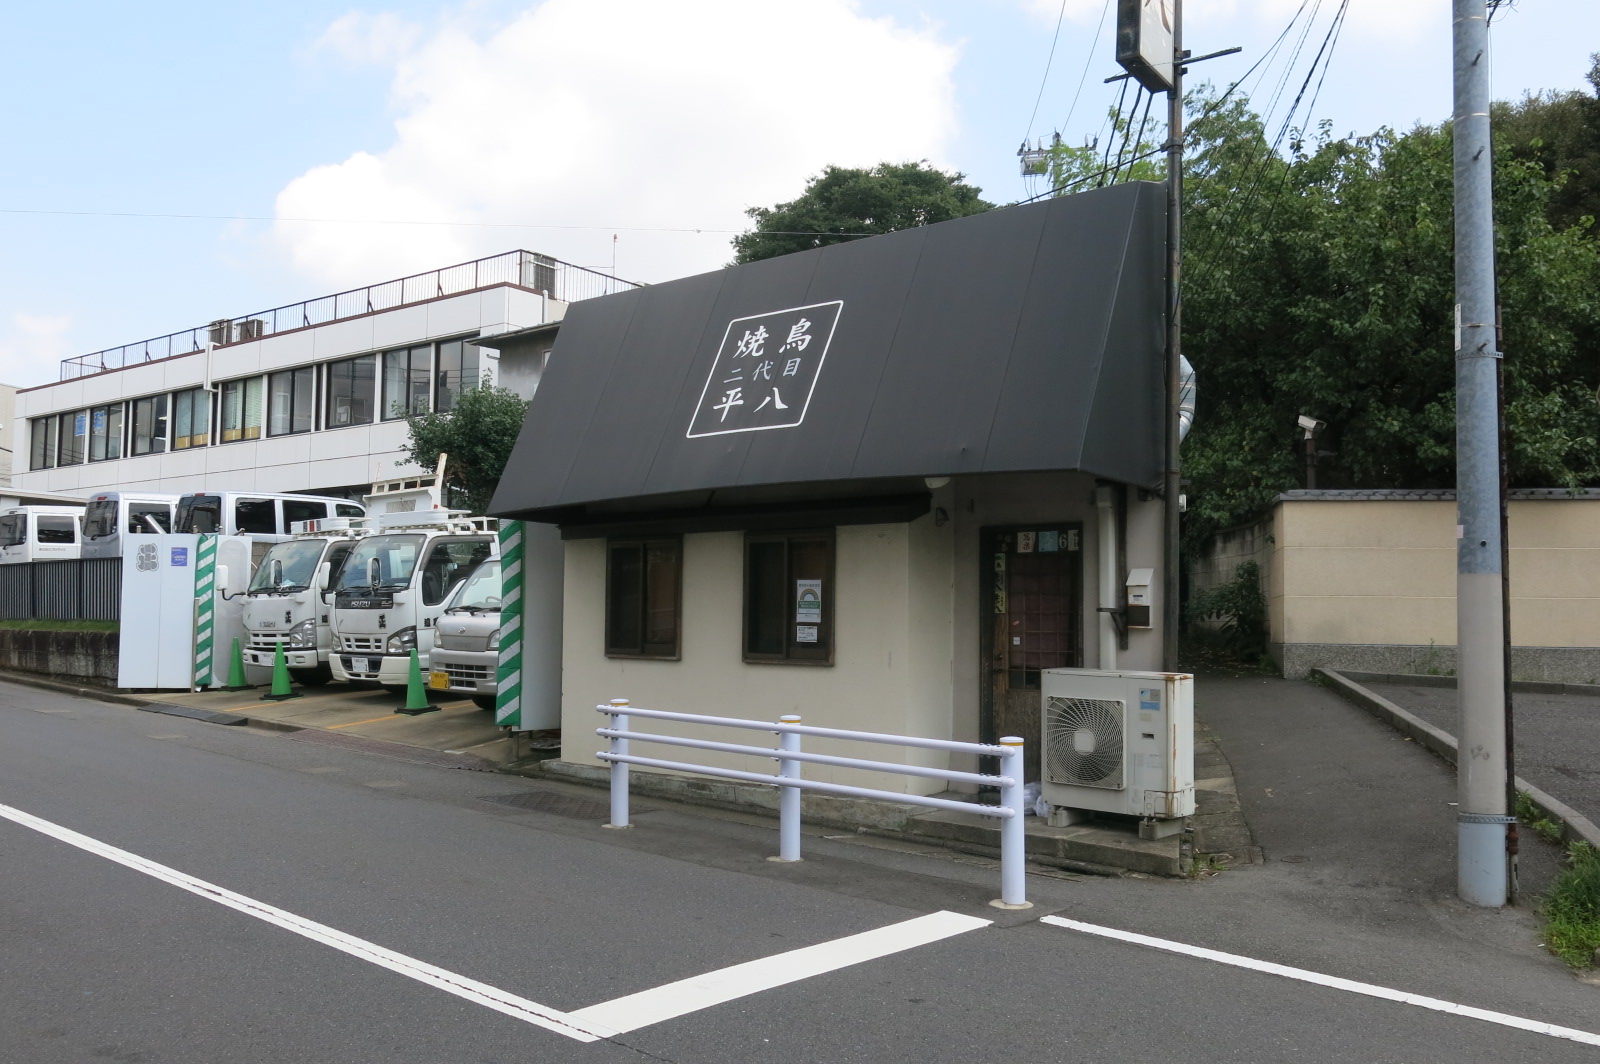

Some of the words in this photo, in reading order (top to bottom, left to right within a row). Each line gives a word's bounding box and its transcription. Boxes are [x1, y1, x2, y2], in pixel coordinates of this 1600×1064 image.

[733, 318, 812, 359] 焼鳥
[724, 358, 801, 384] 二代目
[713, 387, 789, 423] 平八
[351, 600, 371, 608] ISUZU
